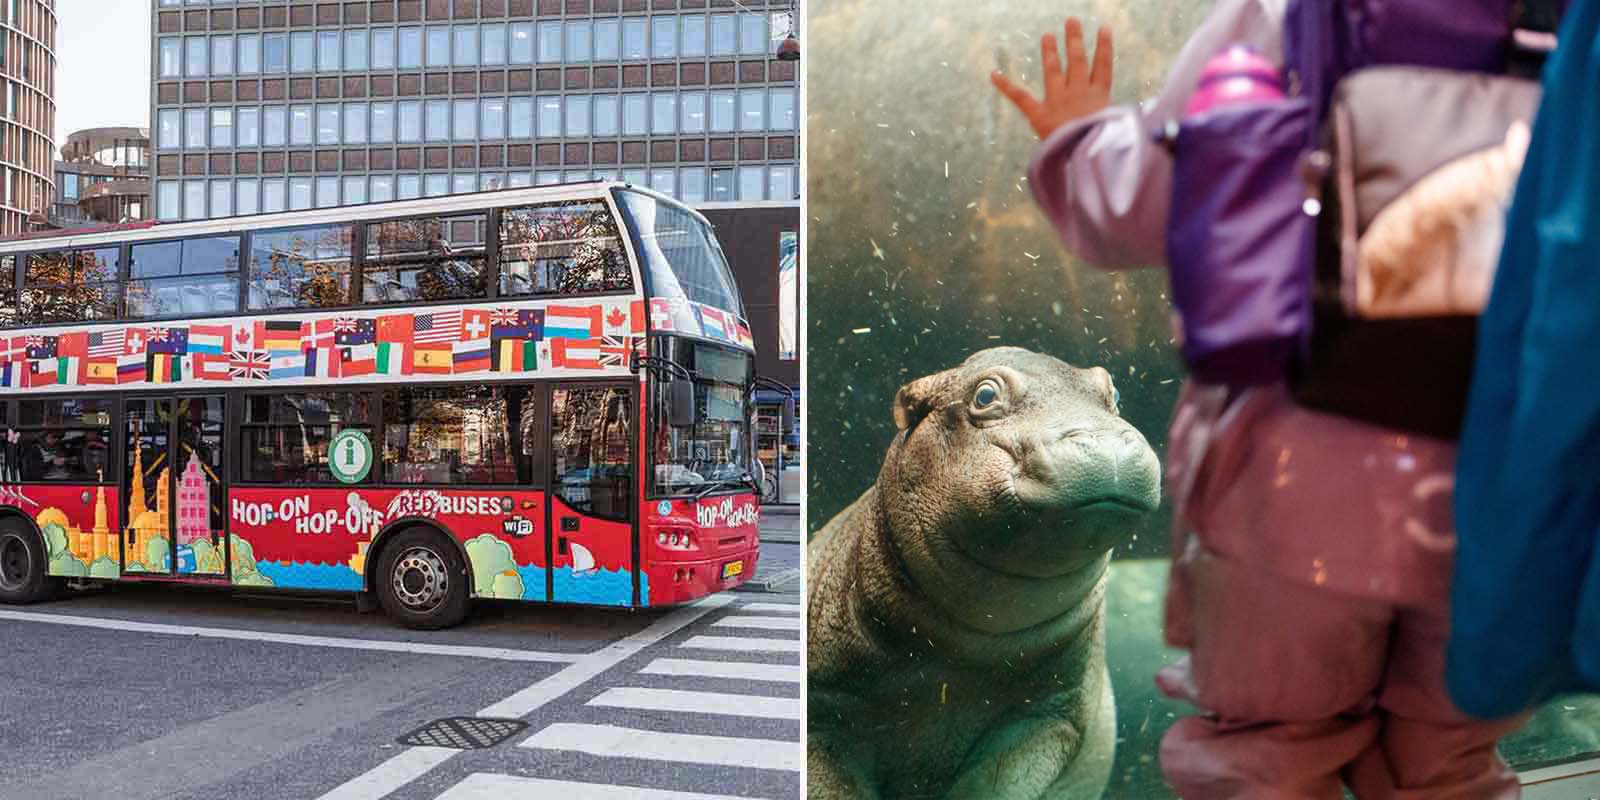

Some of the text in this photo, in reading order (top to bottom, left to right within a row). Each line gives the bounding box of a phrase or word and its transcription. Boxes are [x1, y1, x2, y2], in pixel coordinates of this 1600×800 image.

[232, 495, 310, 525] HOP-ON
[399, 495, 501, 515] RED BUSES
[696, 496, 733, 528] HOP-ON
